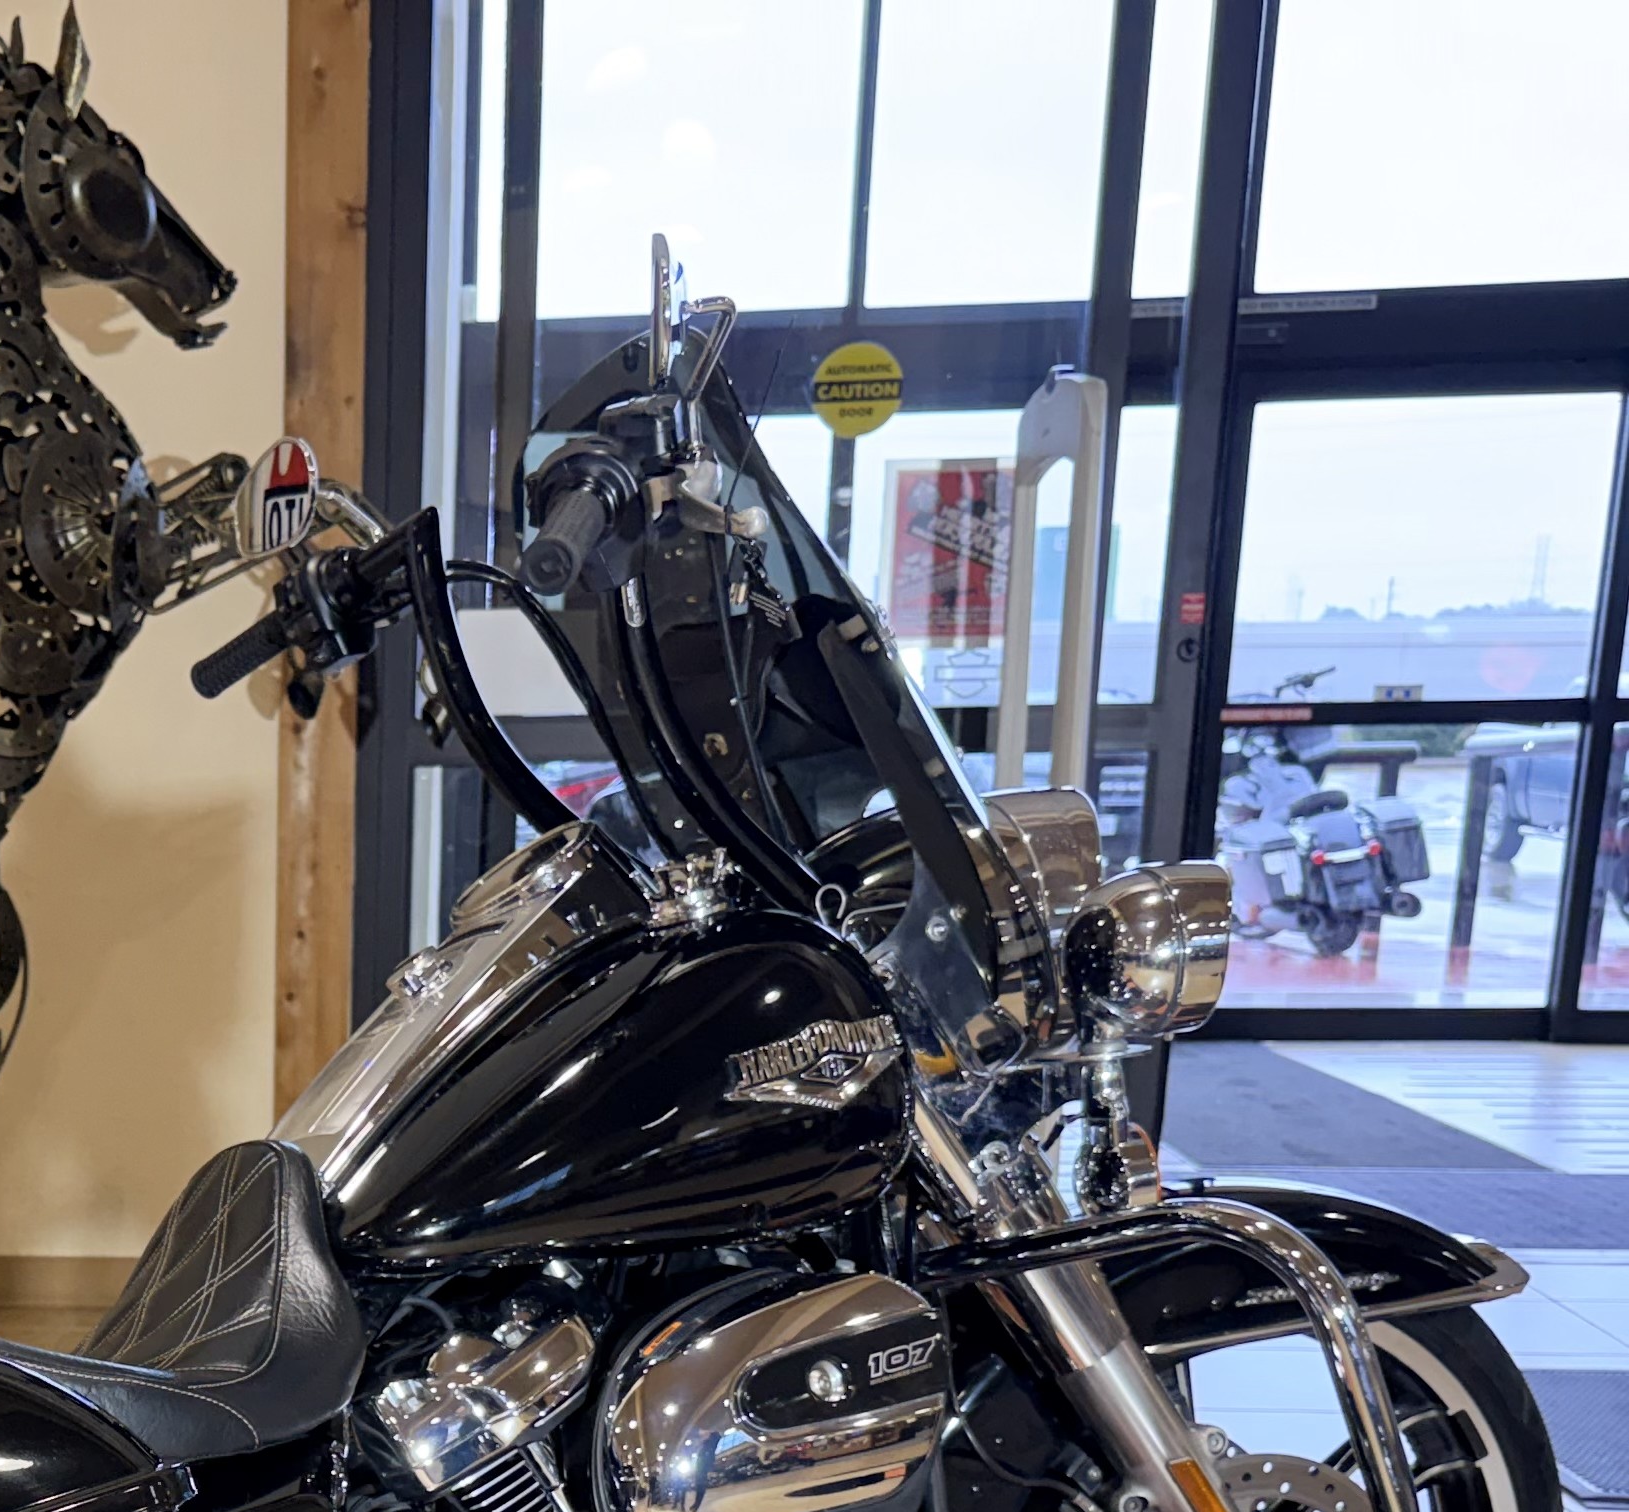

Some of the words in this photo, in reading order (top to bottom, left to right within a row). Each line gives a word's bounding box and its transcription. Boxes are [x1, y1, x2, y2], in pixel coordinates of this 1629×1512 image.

[824, 363, 893, 375] AUTOMATIC
[817, 382, 900, 400] CAUTION
[868, 1334, 939, 1379] 107
